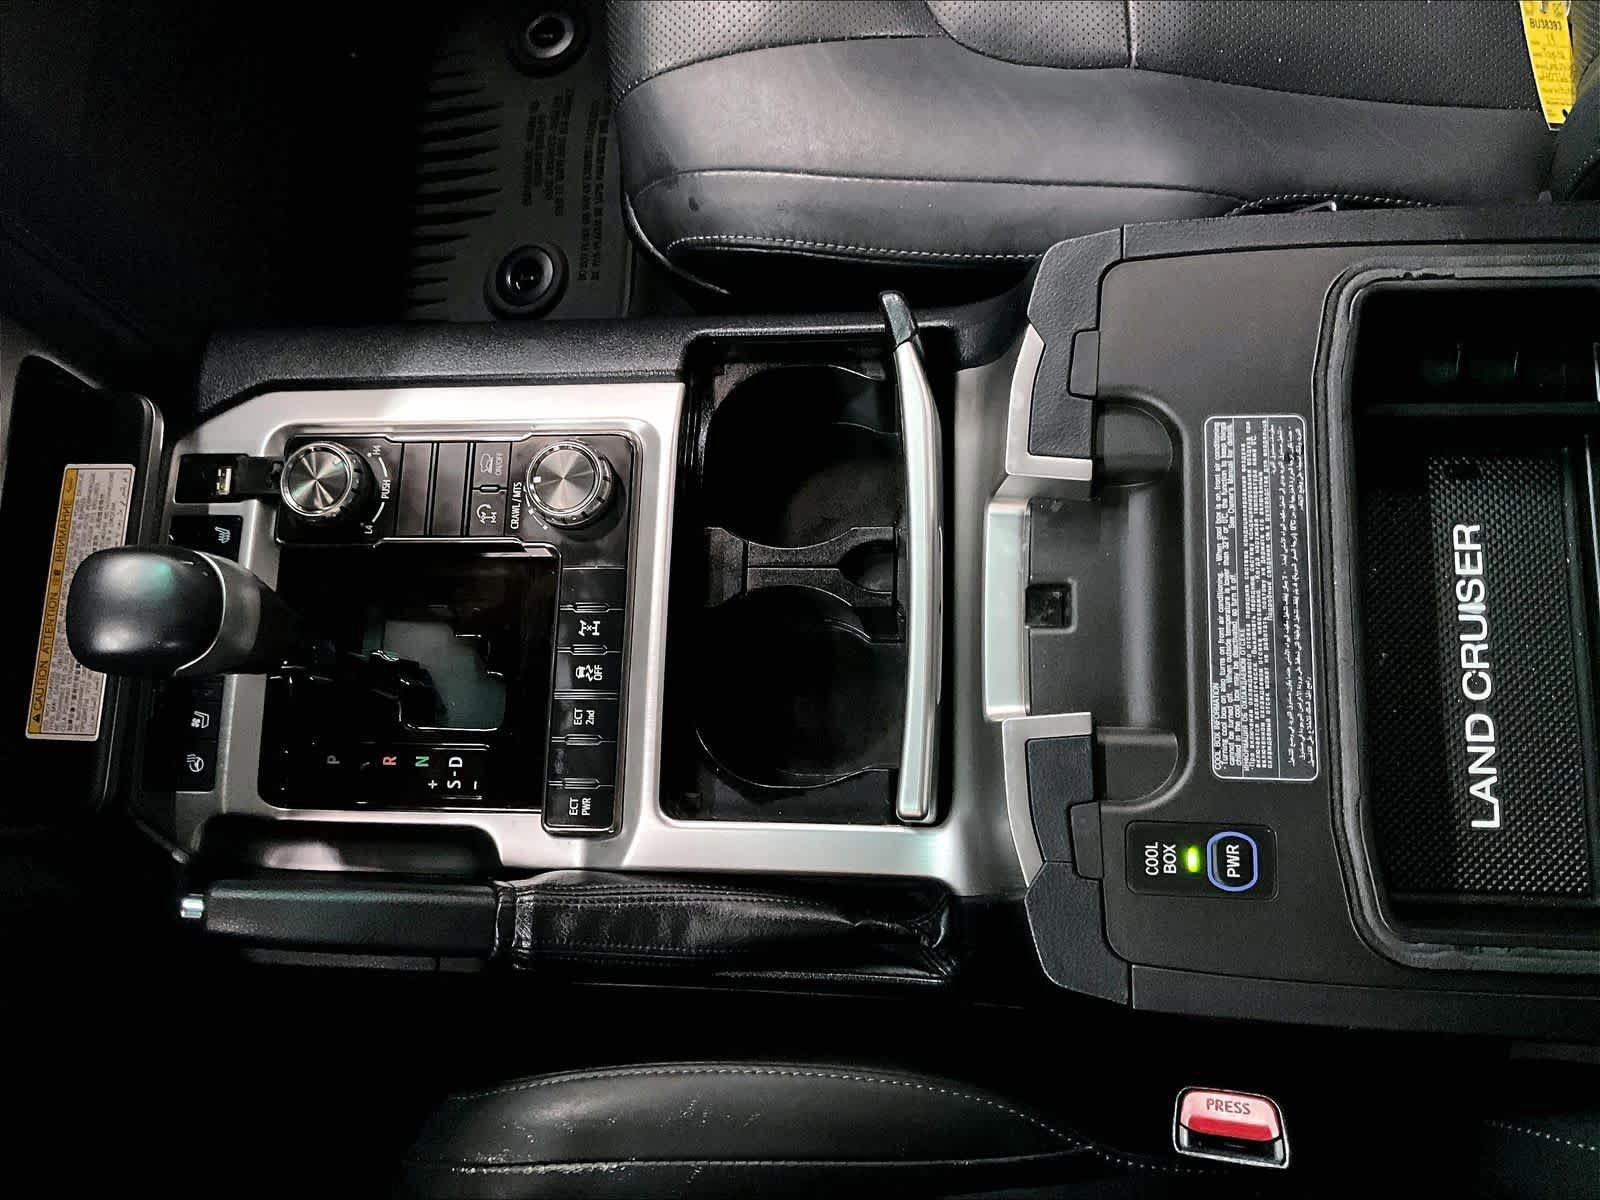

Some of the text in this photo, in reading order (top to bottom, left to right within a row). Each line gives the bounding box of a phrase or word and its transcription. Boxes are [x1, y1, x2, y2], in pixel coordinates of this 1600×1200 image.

[372, 445, 382, 456] H4
[494, 452, 504, 476] ON/OFF
[381, 479, 391, 499] PUSH
[33, 660, 48, 710] CAUTION
[41, 592, 57, 654] ATTENTION
[594, 664, 604, 681] OFF
[1452, 523, 1501, 829] LAND CRUISER
[1212, 682, 1220, 729] INFORMATION
[573, 708, 584, 726] ECT
[584, 709, 595, 725] 2nd
[327, 755, 340, 765] P
[383, 755, 397, 766] R
[415, 755, 430, 767] N
[1213, 750, 1221, 769] COOL
[569, 797, 579, 816] ECT
[580, 797, 592, 816] PWR
[1145, 842, 1159, 875] COOL
[1163, 844, 1177, 874] BOX
[1226, 844, 1240, 878] PWR
[1206, 1098, 1251, 1115] PRESS
